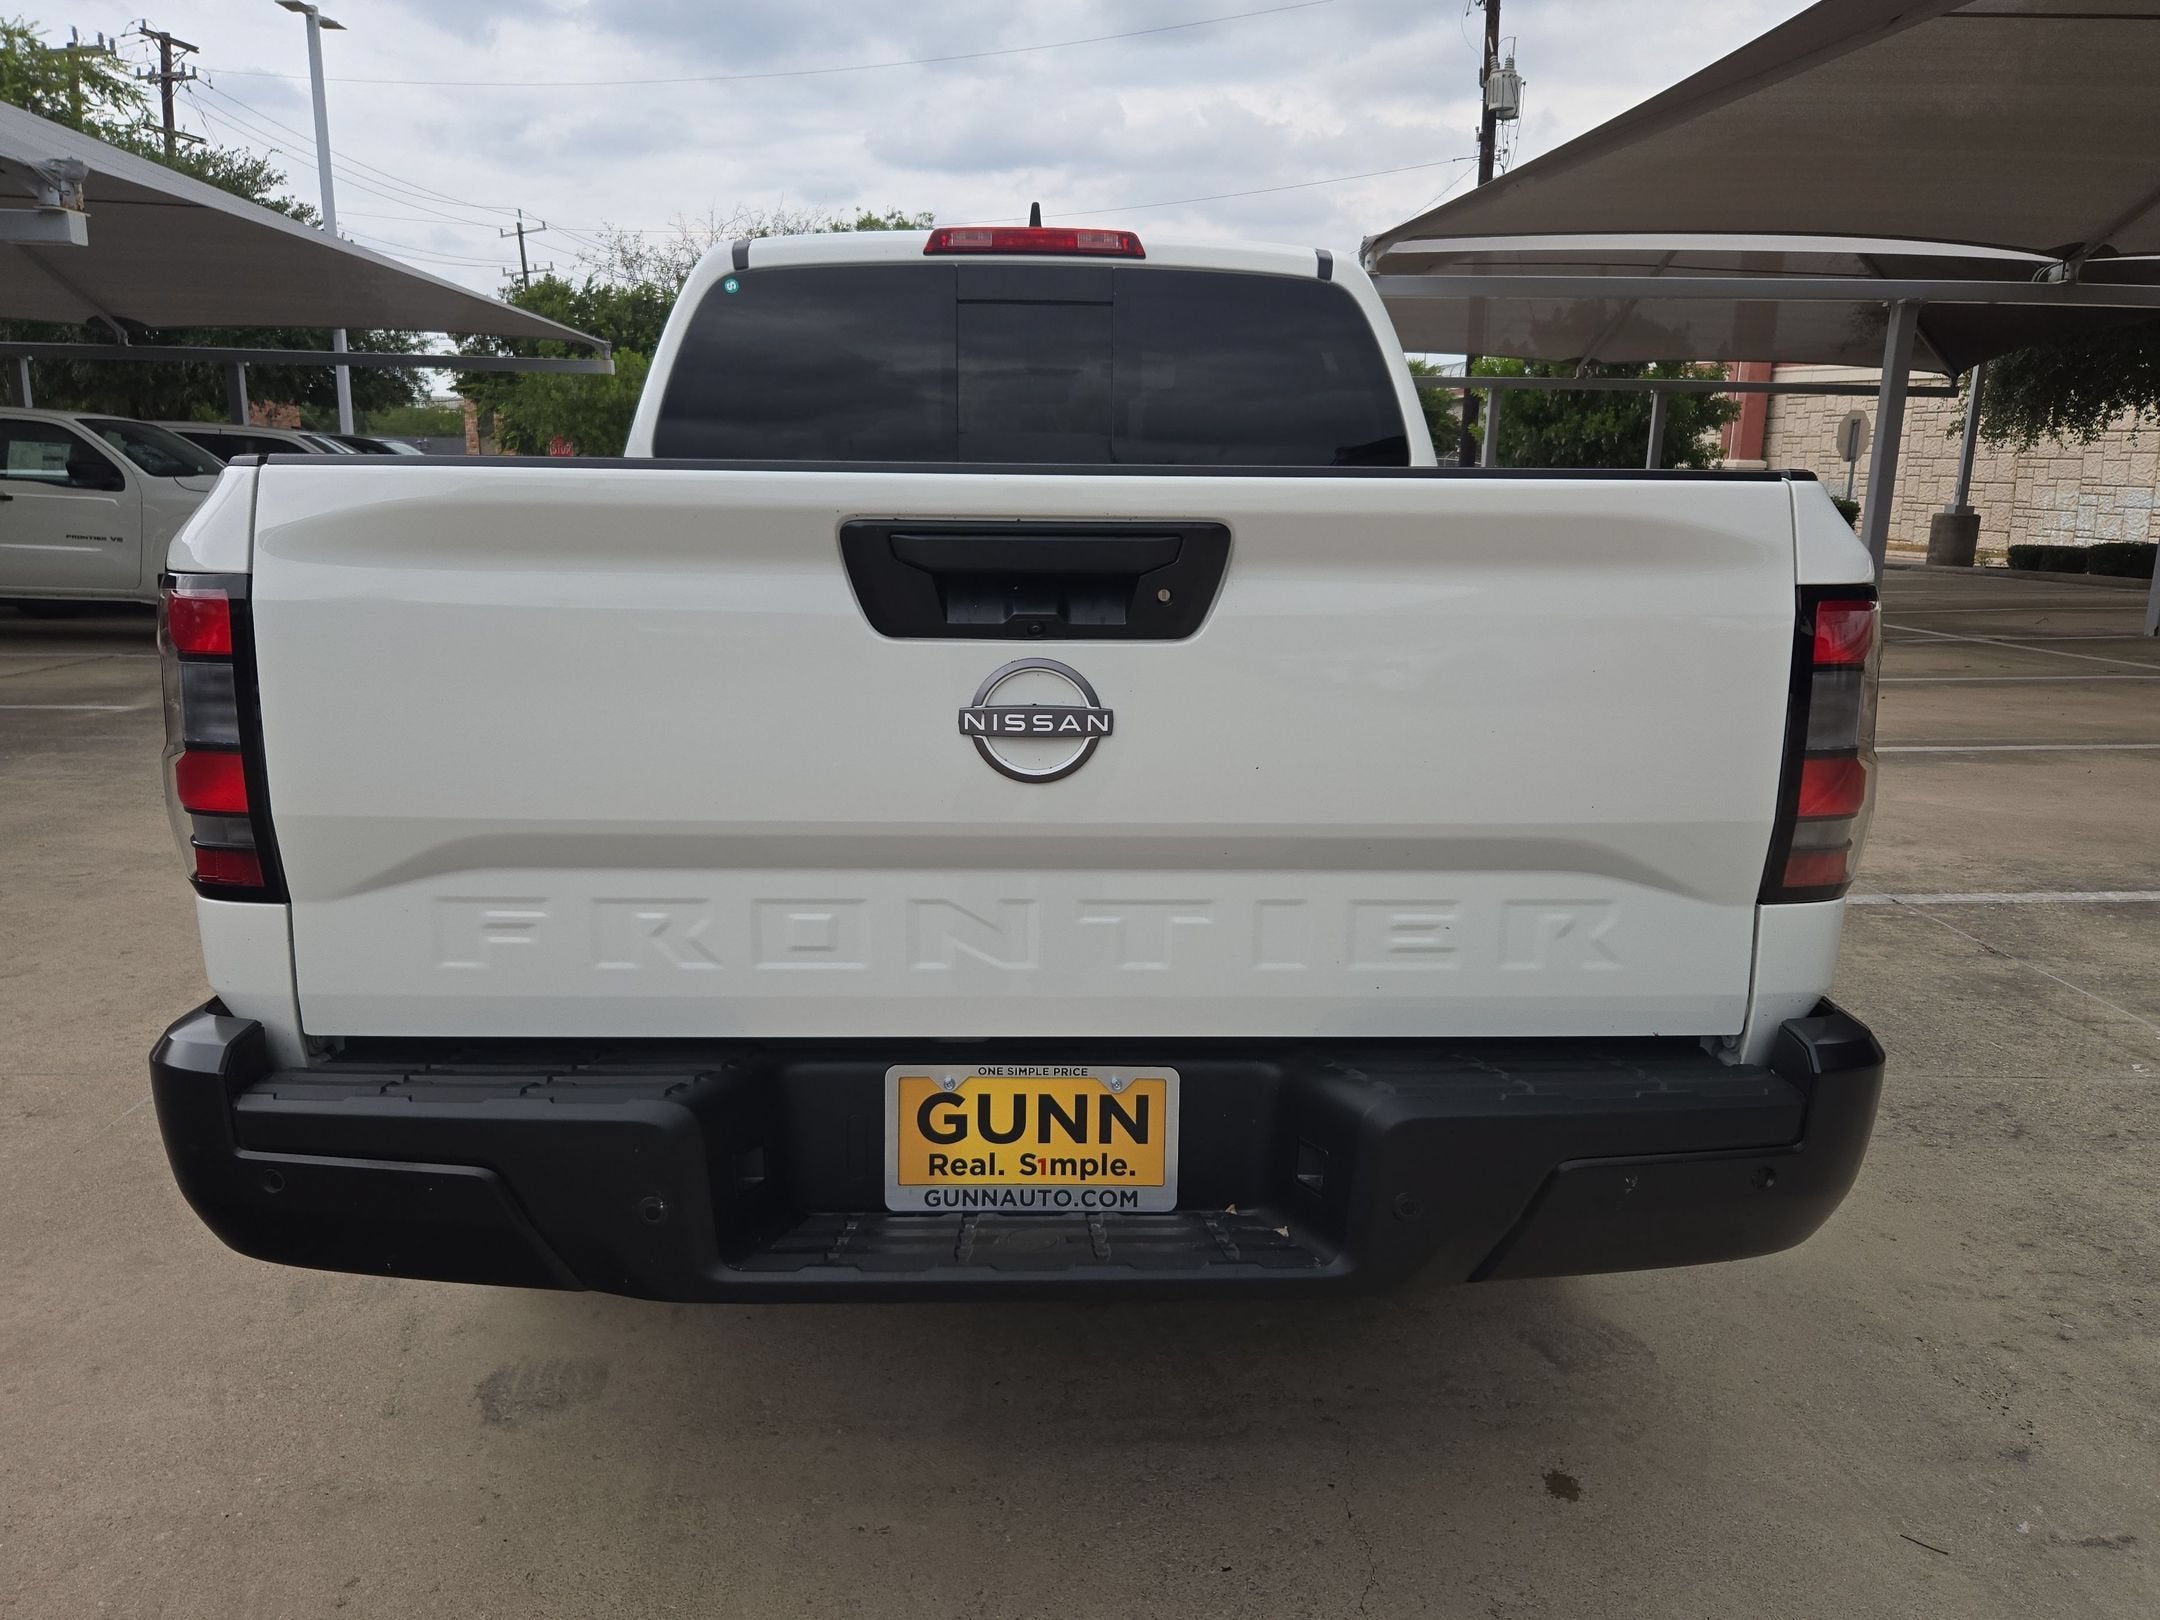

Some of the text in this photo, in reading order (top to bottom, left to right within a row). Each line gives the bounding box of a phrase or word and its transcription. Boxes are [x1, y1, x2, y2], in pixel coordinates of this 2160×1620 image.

[964, 712, 1109, 732] NISSAN
[434, 896, 1624, 971] FRONTIER
[978, 1066, 1089, 1077] ONE SIMPLE PRICE
[917, 1091, 1149, 1145] GUNN
[928, 1152, 1005, 1177] Real.
[924, 1188, 1139, 1208] GUNNAUTO.COM
